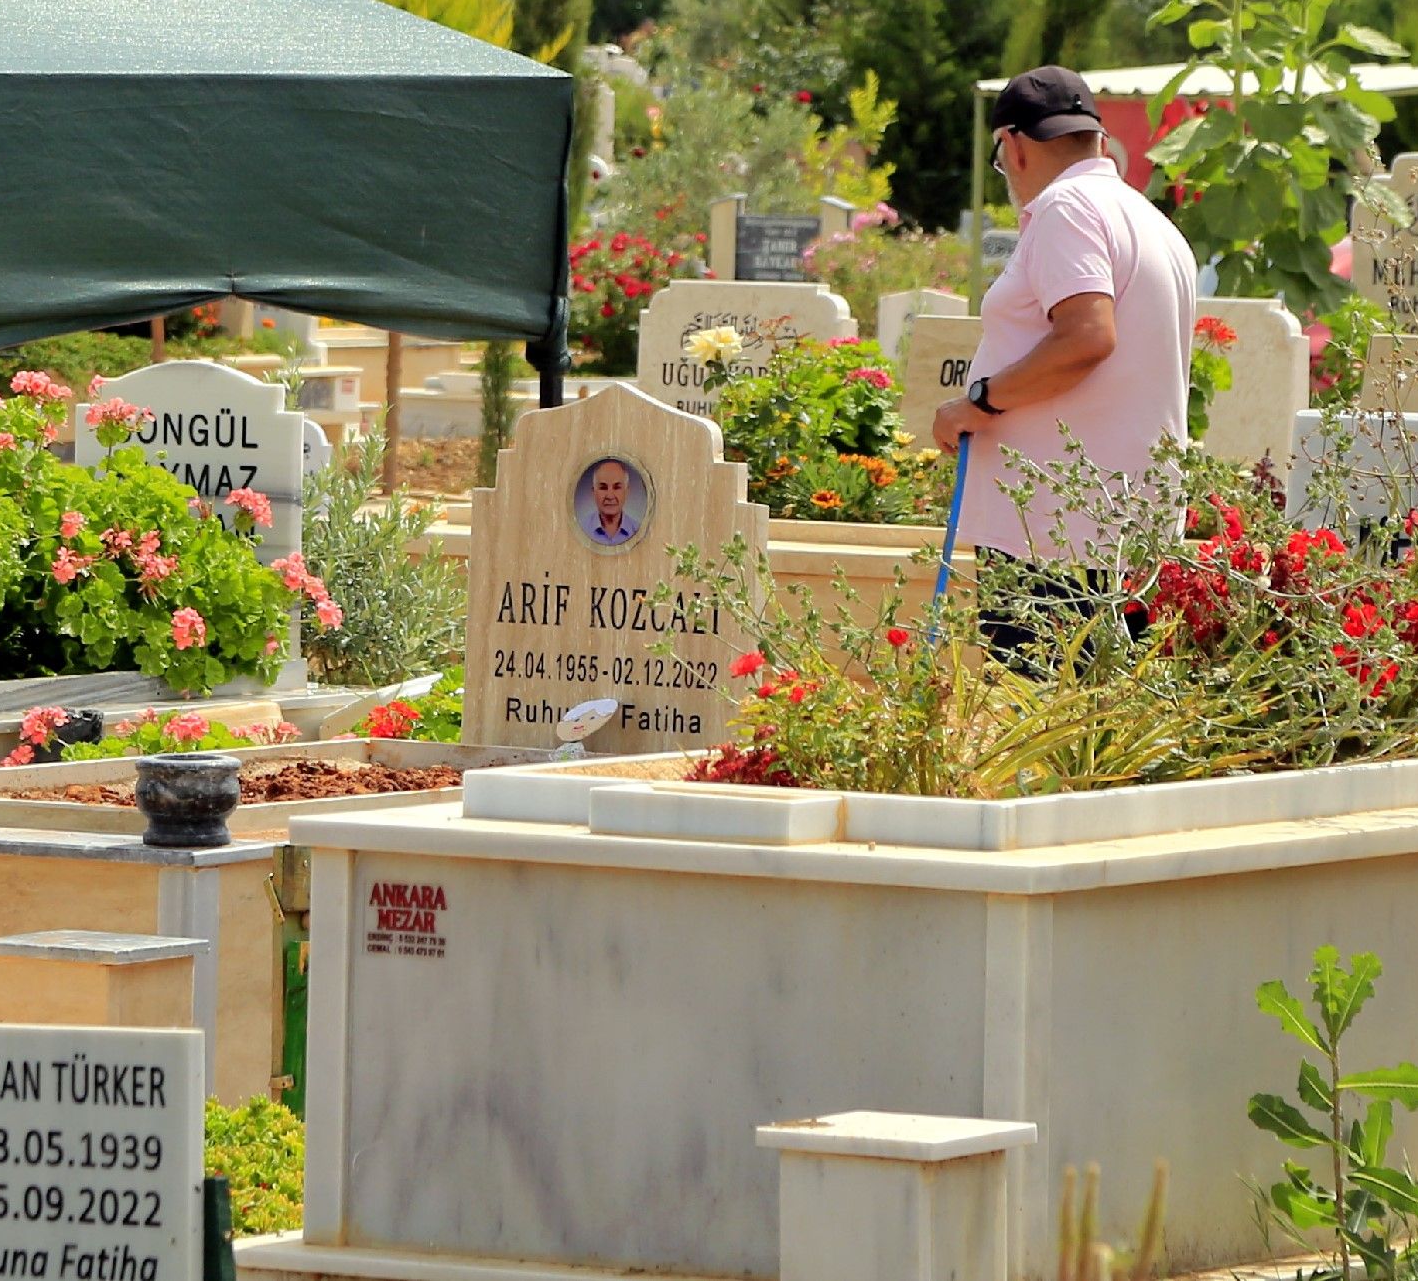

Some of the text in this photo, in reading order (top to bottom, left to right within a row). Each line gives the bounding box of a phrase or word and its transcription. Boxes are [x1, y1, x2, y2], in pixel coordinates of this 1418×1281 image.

[662, 356, 710, 387] UĞU
[940, 359, 972, 387] OR
[123, 408, 259, 449] ONGÜL
[497, 571, 571, 627] ARİF
[494, 650, 718, 690] 24.04.1955-02.12.2022
[621, 704, 701, 734] Fatiha
[369, 883, 447, 910] ANKARA
[377, 909, 435, 933] MEZAR
[52, 1053, 167, 1108] TÜRKER
[59, 1243, 158, 1281] Fatiha
